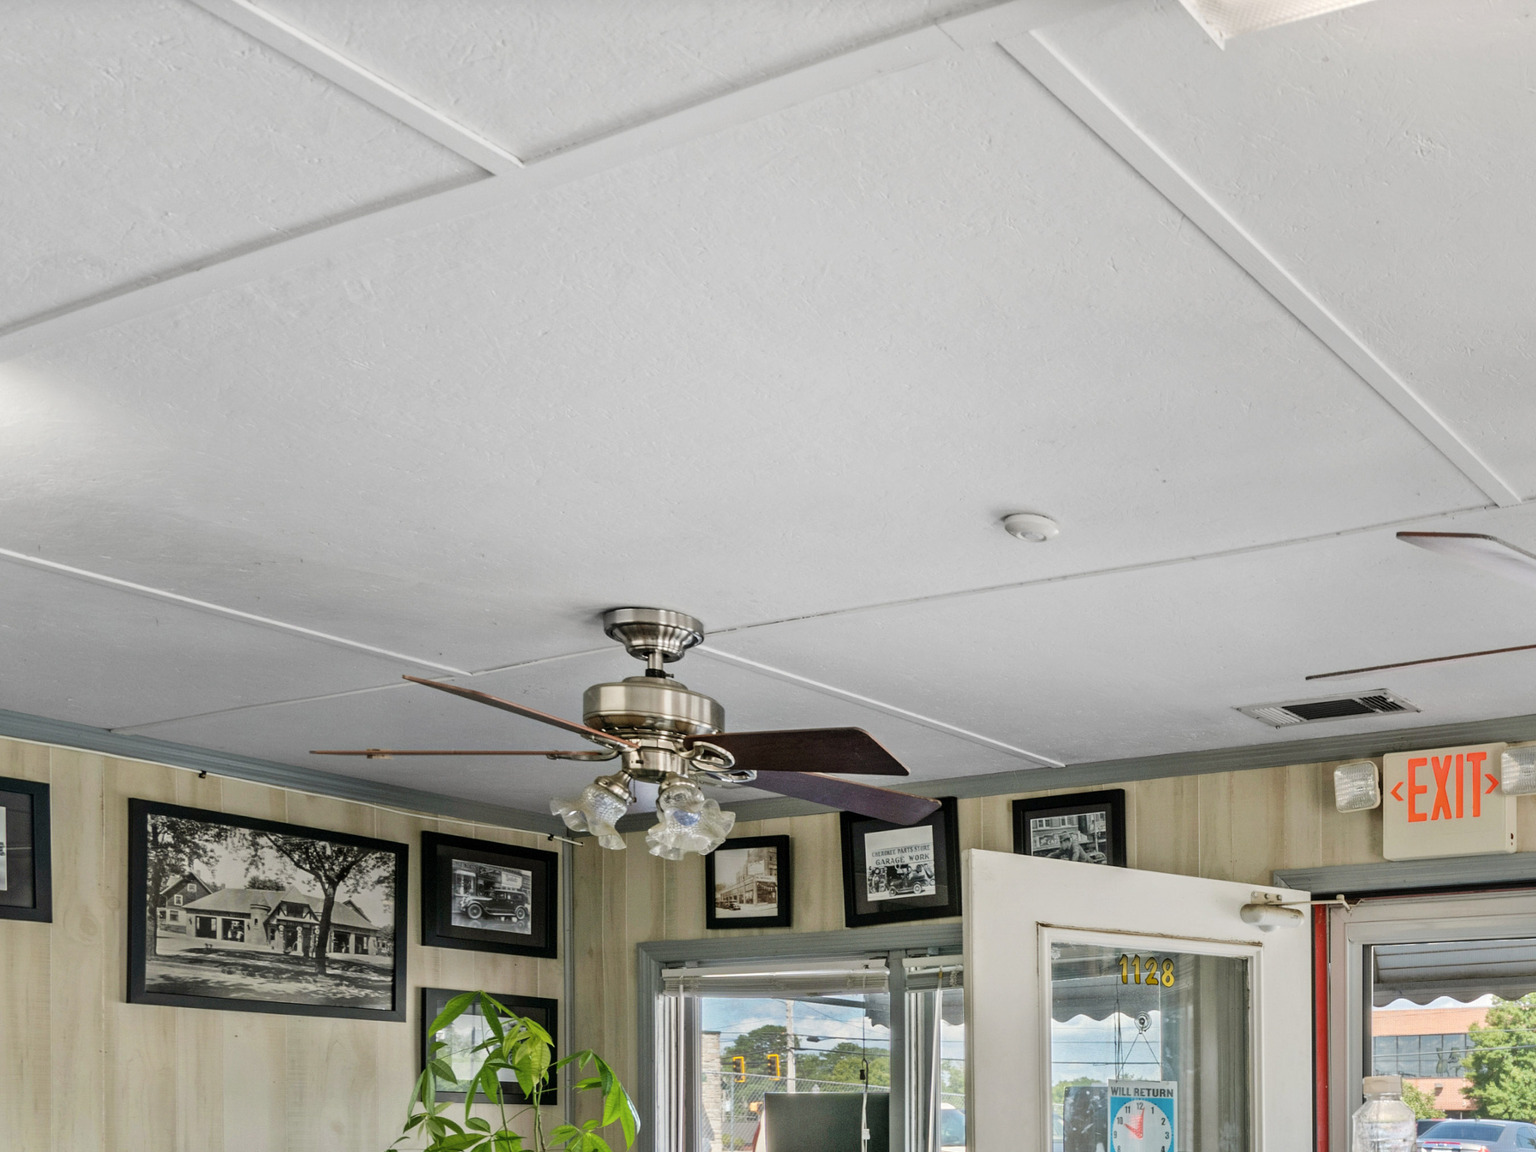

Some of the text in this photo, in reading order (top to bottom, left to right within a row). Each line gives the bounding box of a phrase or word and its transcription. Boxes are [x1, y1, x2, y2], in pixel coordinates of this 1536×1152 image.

[1408, 752, 1487, 823] EXIT
[897, 846, 913, 854] PARTS
[875, 853, 930, 866] GARAGE WORK
[1119, 954, 1175, 988] 1128
[1110, 1086, 1174, 1098] WILL RETURN
[1125, 1106, 1131, 1114] 11
[1161, 1117, 1166, 1125] 2
[1165, 1131, 1170, 1139] 3
